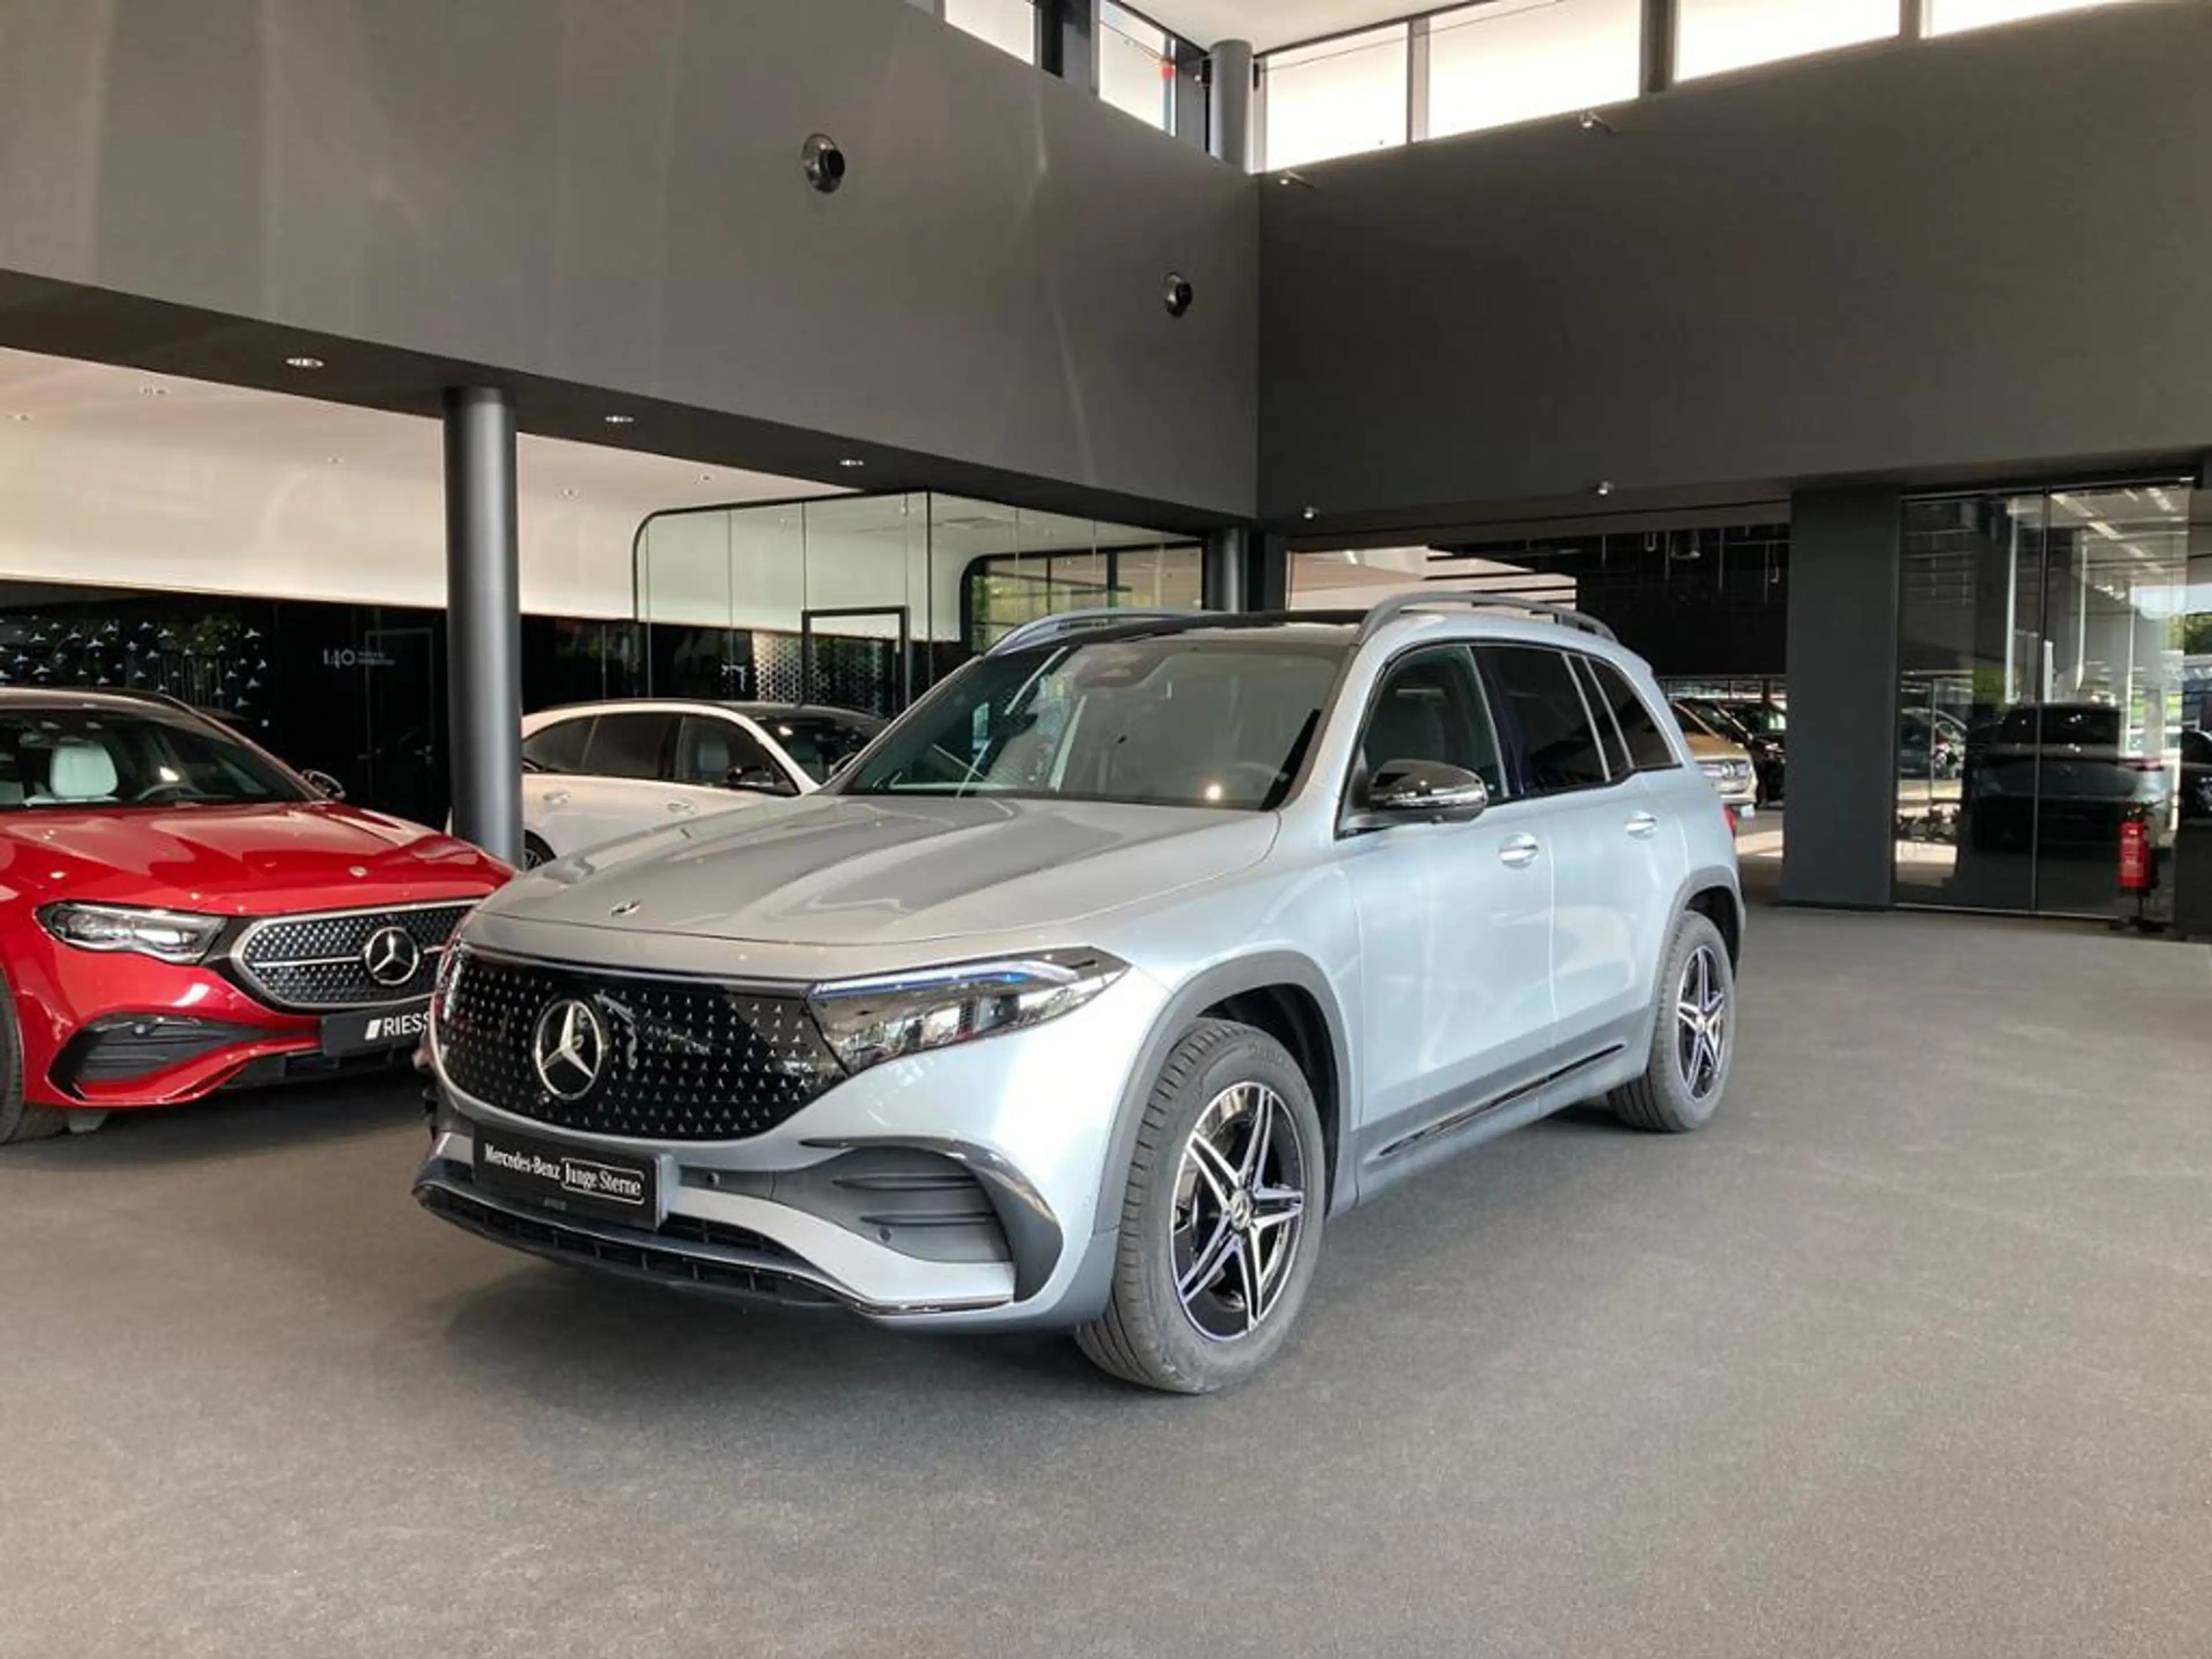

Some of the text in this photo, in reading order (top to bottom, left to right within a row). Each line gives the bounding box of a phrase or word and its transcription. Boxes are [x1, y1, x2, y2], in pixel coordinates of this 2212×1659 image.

[484, 1143, 641, 1196] Mercedes-Benz Junge Sterne
